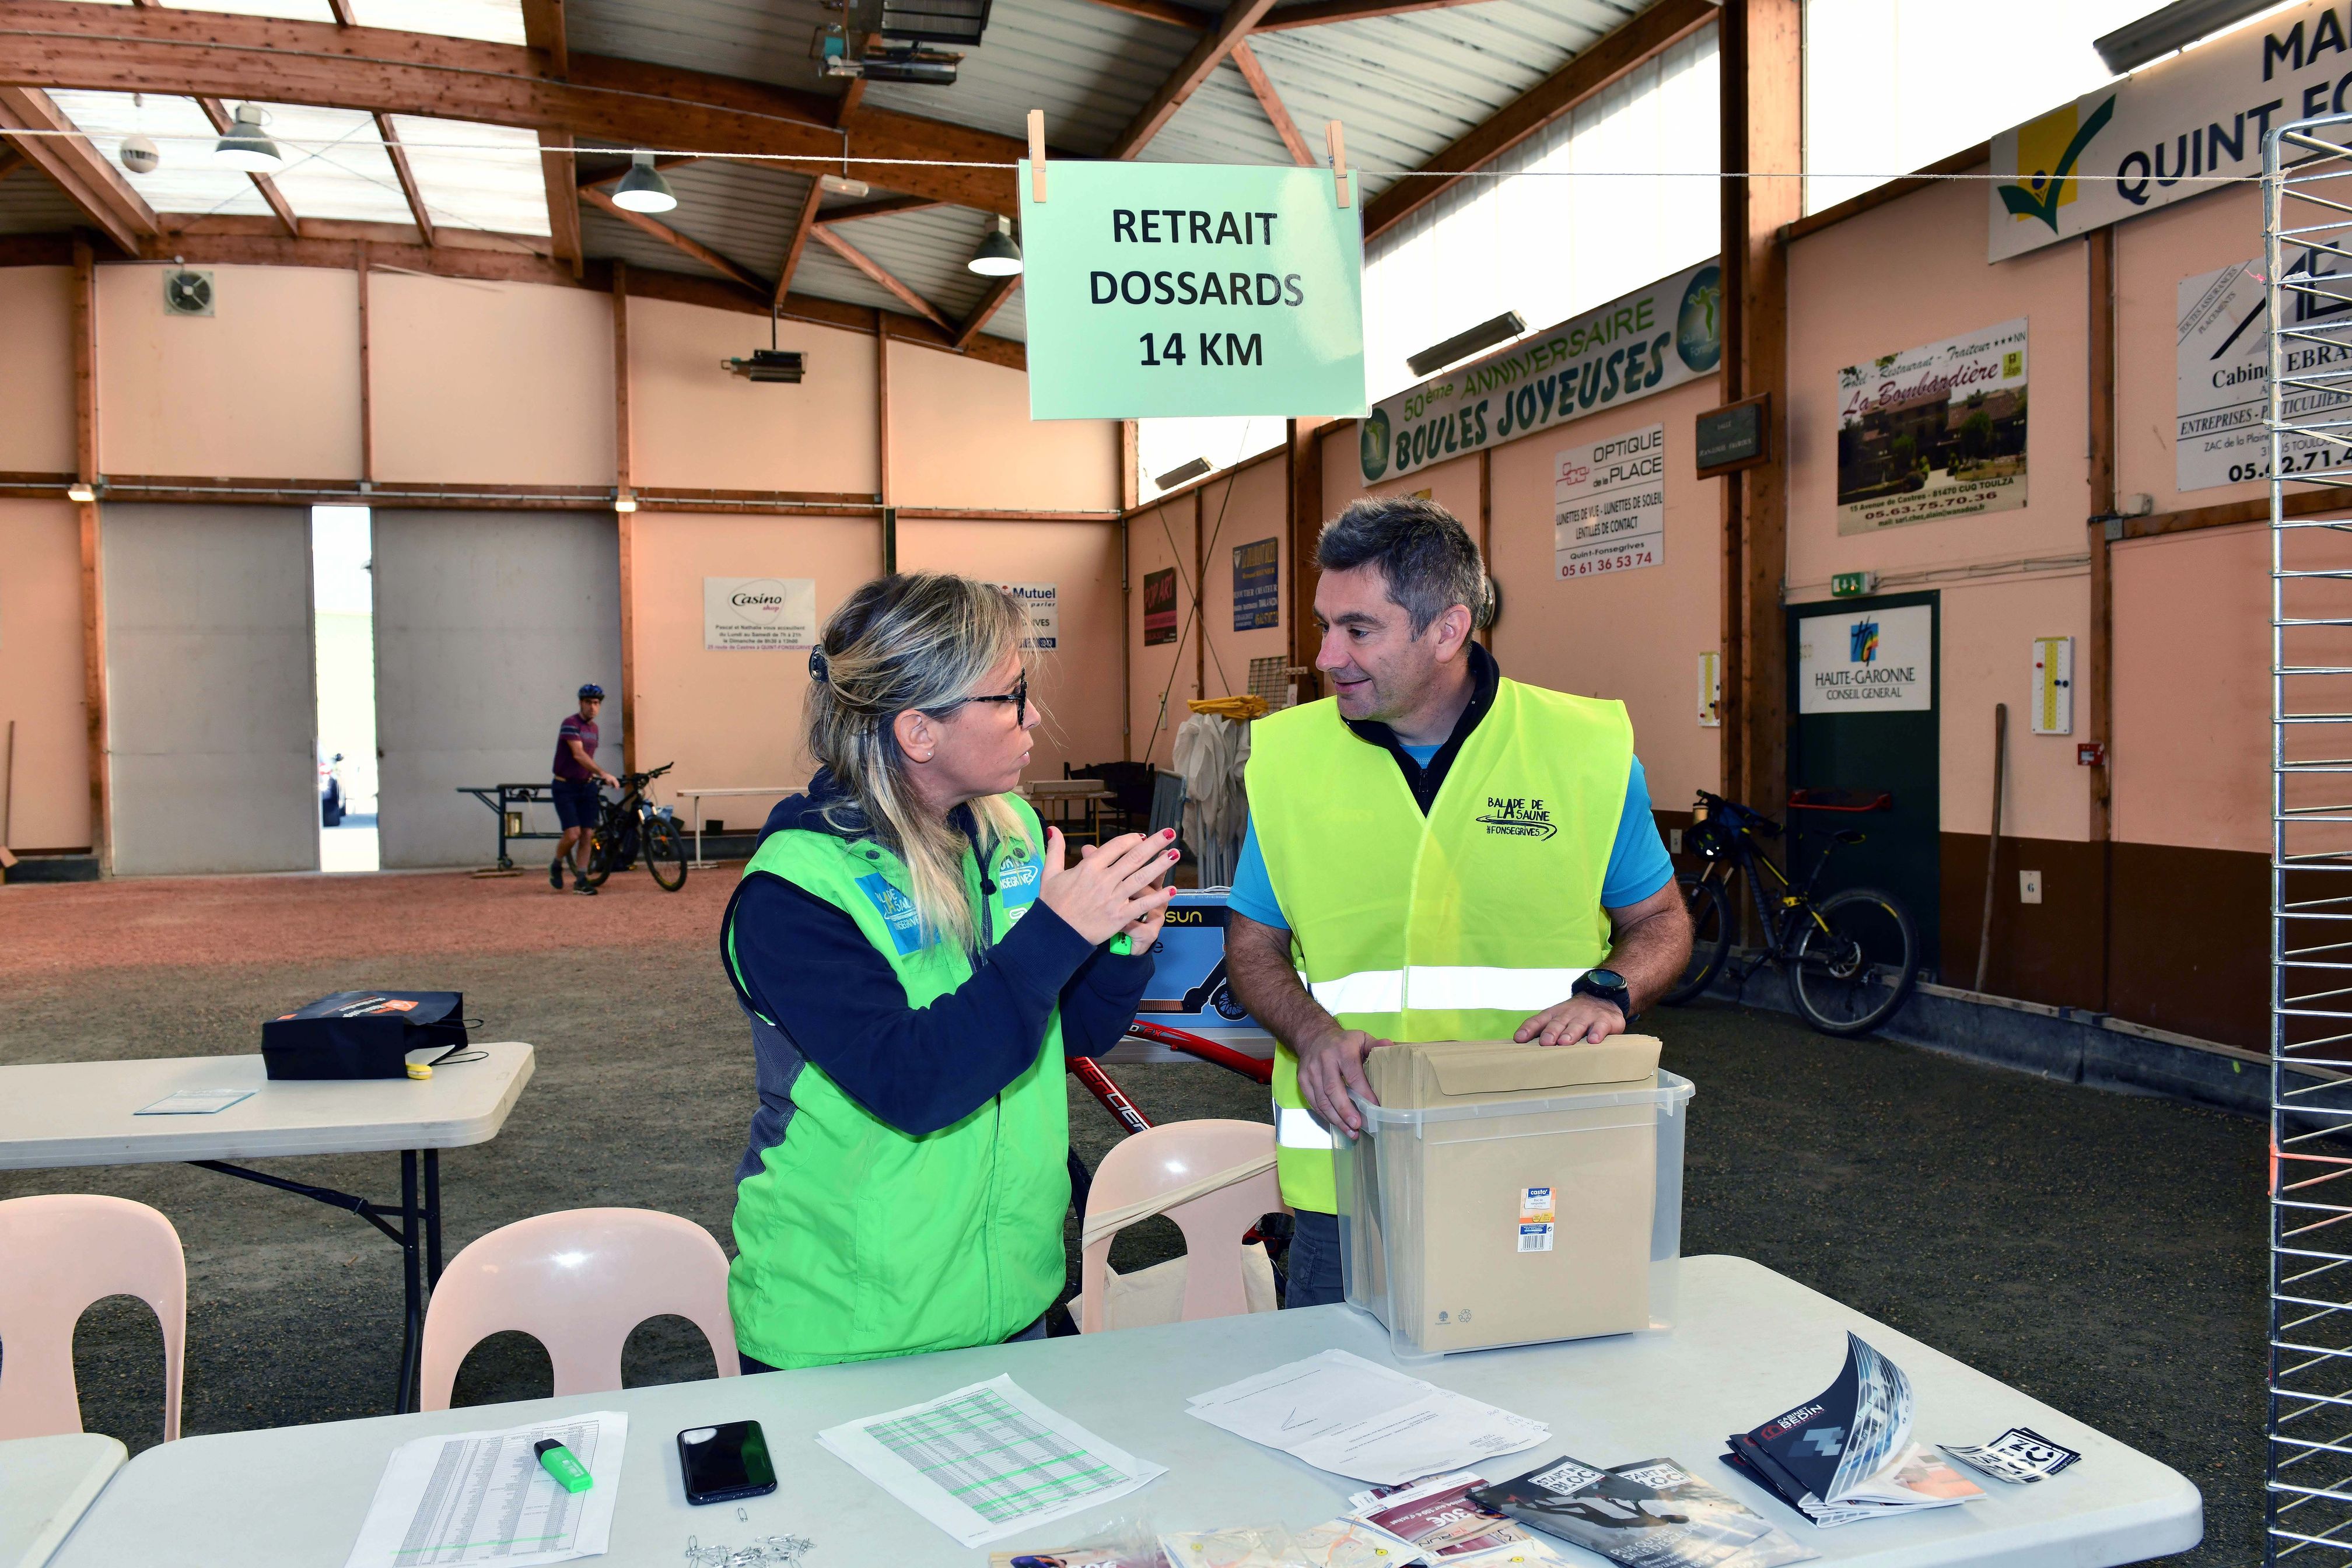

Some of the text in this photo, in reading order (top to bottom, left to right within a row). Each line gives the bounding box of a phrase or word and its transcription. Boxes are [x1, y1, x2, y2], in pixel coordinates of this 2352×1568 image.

[2263, 6, 2352, 82] MA
[2117, 98, 2283, 205] QUINT
[1113, 209, 1278, 245] RETRAIT
[1090, 271, 1304, 306] DOSSARDS
[1139, 332, 1263, 366] 14 KM
[1947, 343, 1990, 362] Traiteur
[1403, 383, 1455, 422] 50ème
[1460, 298, 1656, 401] ANNIVERSAIRE
[2213, 363, 2268, 388] Cabin
[2287, 340, 2352, 372] EBRA
[1842, 359, 1999, 416] La Bombardière
[1395, 331, 1672, 471] BOULES JOYEUSES
[2181, 409, 2252, 436] ENTREPRISES
[2247, 432, 2269, 444] Plain
[1609, 457, 1662, 483] PLACE
[1556, 492, 1662, 526] LUNETTES DE VUE LUNETTES DE SOLEIL
[1860, 501, 1885, 510] Avenue
[1898, 494, 1926, 503] Castres
[1865, 491, 1998, 520] 05.63.75.70.36
[1576, 516, 1638, 540] LENTILLES DE CONTACT
[1570, 541, 1644, 560] Quint-Fonsegrives
[1562, 552, 1652, 577] 05 61 36 53 74
[732, 593, 782, 606] Casino
[1013, 587, 1056, 598] Mutuel
[1815, 667, 1916, 687] HAUTE-GARONNE
[1826, 687, 1902, 700] CONSEIL GENERAL
[1488, 797, 1544, 810] BALADE DE
[1516, 809, 1550, 821] SAUNE
[2027, 883, 2035, 892] 6
[1777, 1406, 1808, 1424] CABINET
[1536, 1468, 1570, 1486] START
[1550, 1470, 1596, 1492] BLOC
[1625, 1469, 1657, 1479] TART
[1390, 1513, 1415, 1525] d'achat
[1426, 1508, 1473, 1527] 30€
[1609, 1528, 1674, 1556] PLUS QU'UNE
[1622, 1546, 1653, 1561] SALLE
